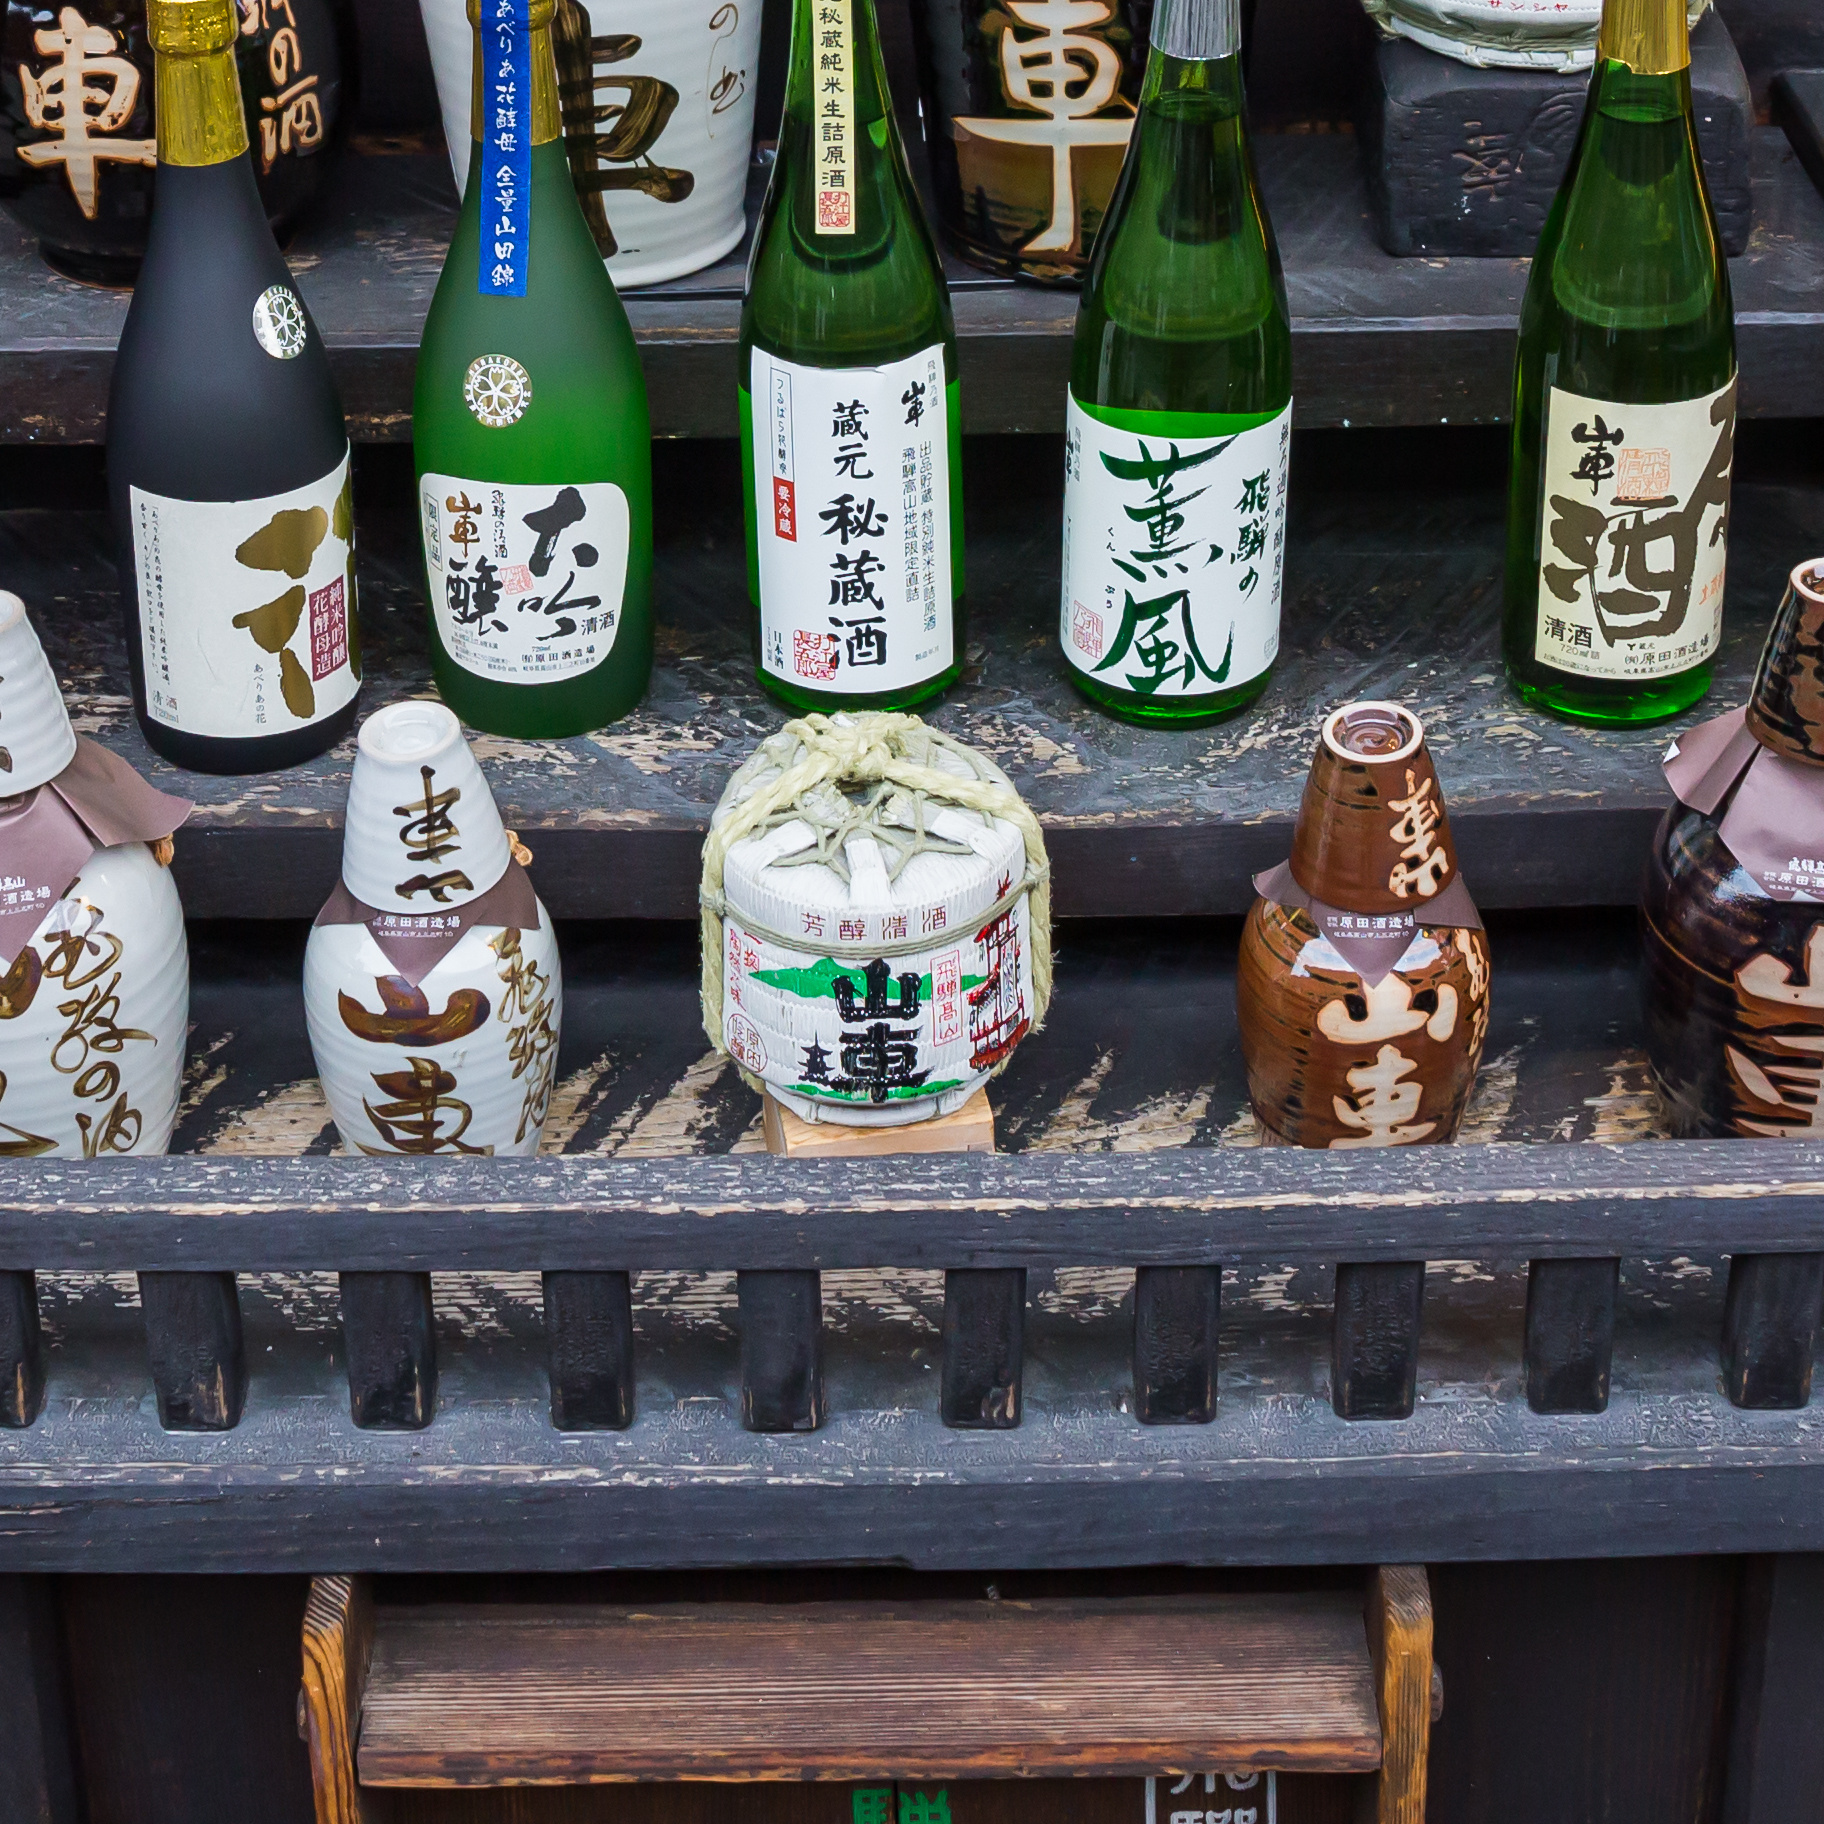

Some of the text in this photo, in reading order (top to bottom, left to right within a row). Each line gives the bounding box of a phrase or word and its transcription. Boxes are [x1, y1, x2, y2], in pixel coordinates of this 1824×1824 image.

[777, 484, 792, 536] 要冷蔵
[313, 591, 331, 676] 花酵母造
[330, 582, 345, 668] 純米吟醸
[581, 609, 615, 636] 清酒
[1544, 614, 1593, 649] 清酒
[801, 905, 947, 942] 芳醇清酒
